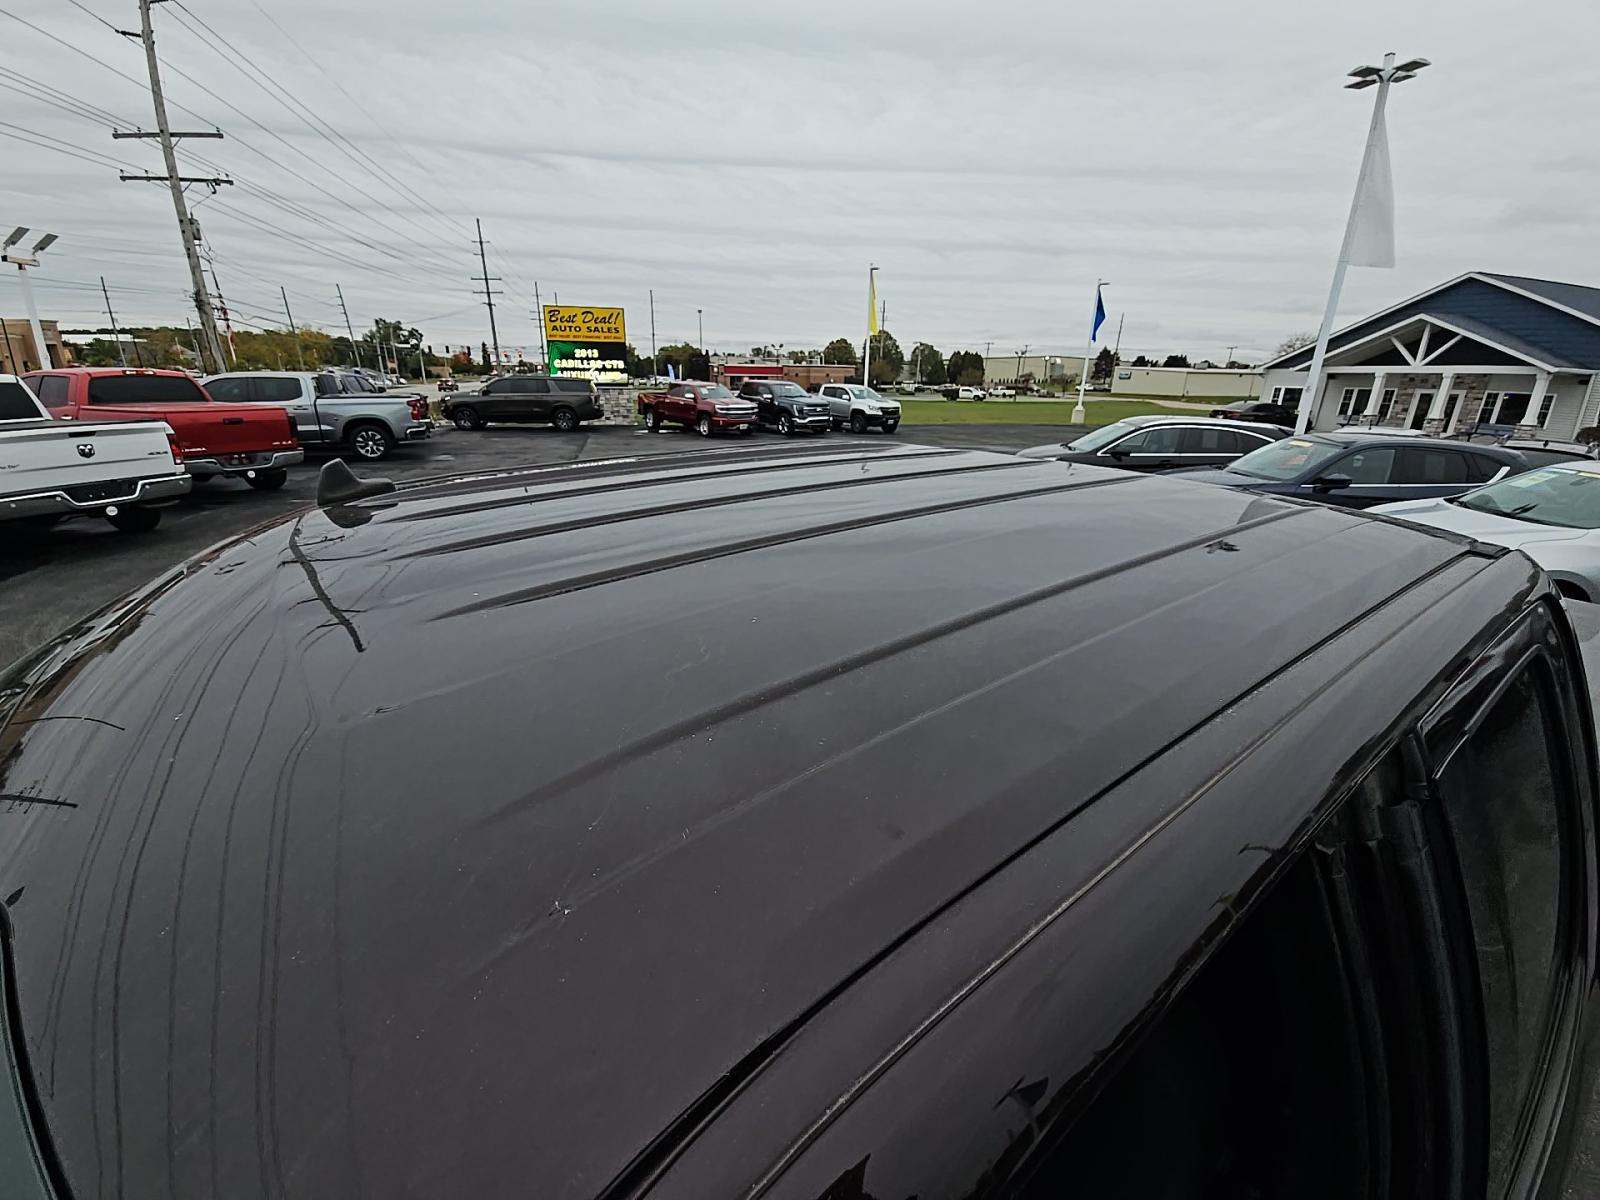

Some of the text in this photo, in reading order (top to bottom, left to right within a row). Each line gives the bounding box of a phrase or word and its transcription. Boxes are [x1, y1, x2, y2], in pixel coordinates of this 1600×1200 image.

[548, 309, 620, 325] Best Deal!
[586, 326, 620, 334] SALES
